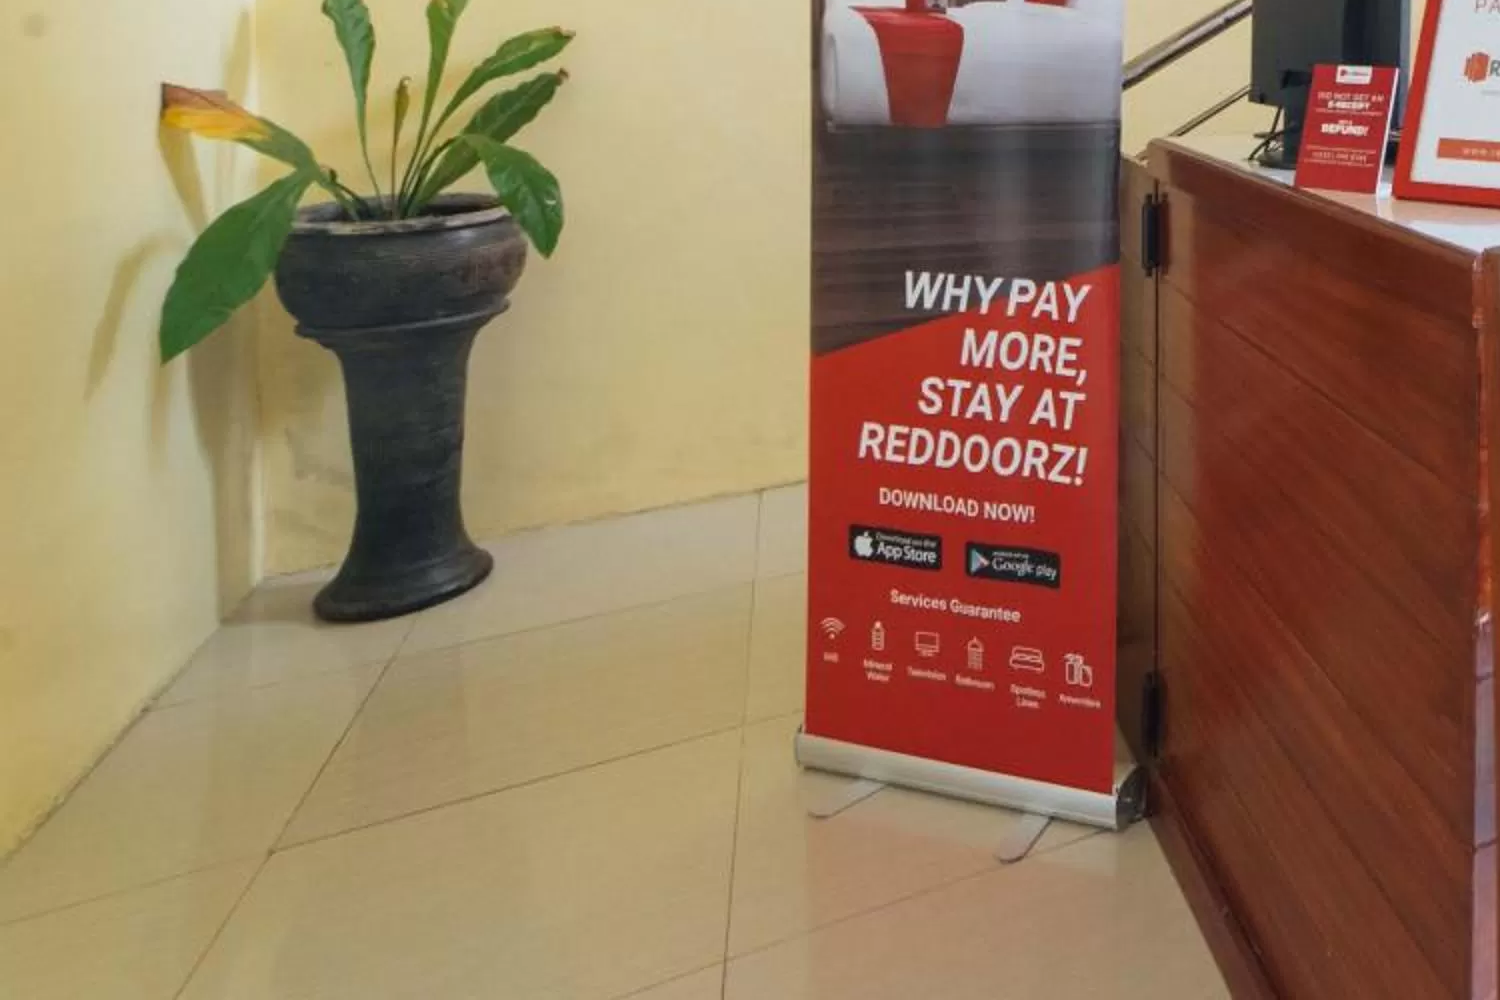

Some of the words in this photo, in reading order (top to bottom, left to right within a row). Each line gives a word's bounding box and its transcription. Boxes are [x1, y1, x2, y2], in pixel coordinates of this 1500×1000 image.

[905, 270, 1004, 315] WHY
[1005, 278, 1092, 323] PAY
[960, 327, 1087, 386] MORE,
[918, 377, 1024, 423] STAY
[1029, 388, 1086, 431] AT
[858, 421, 1088, 486] REDDOORZ!
[879, 487, 979, 518] DOWNLOAD
[984, 502, 1036, 524] NOW!
[876, 542, 903, 561] App
[904, 546, 937, 564] Store
[992, 557, 1034, 577] Google
[1036, 563, 1057, 581] play
[890, 588, 947, 612] Services
[949, 598, 1022, 624] Guarantee
